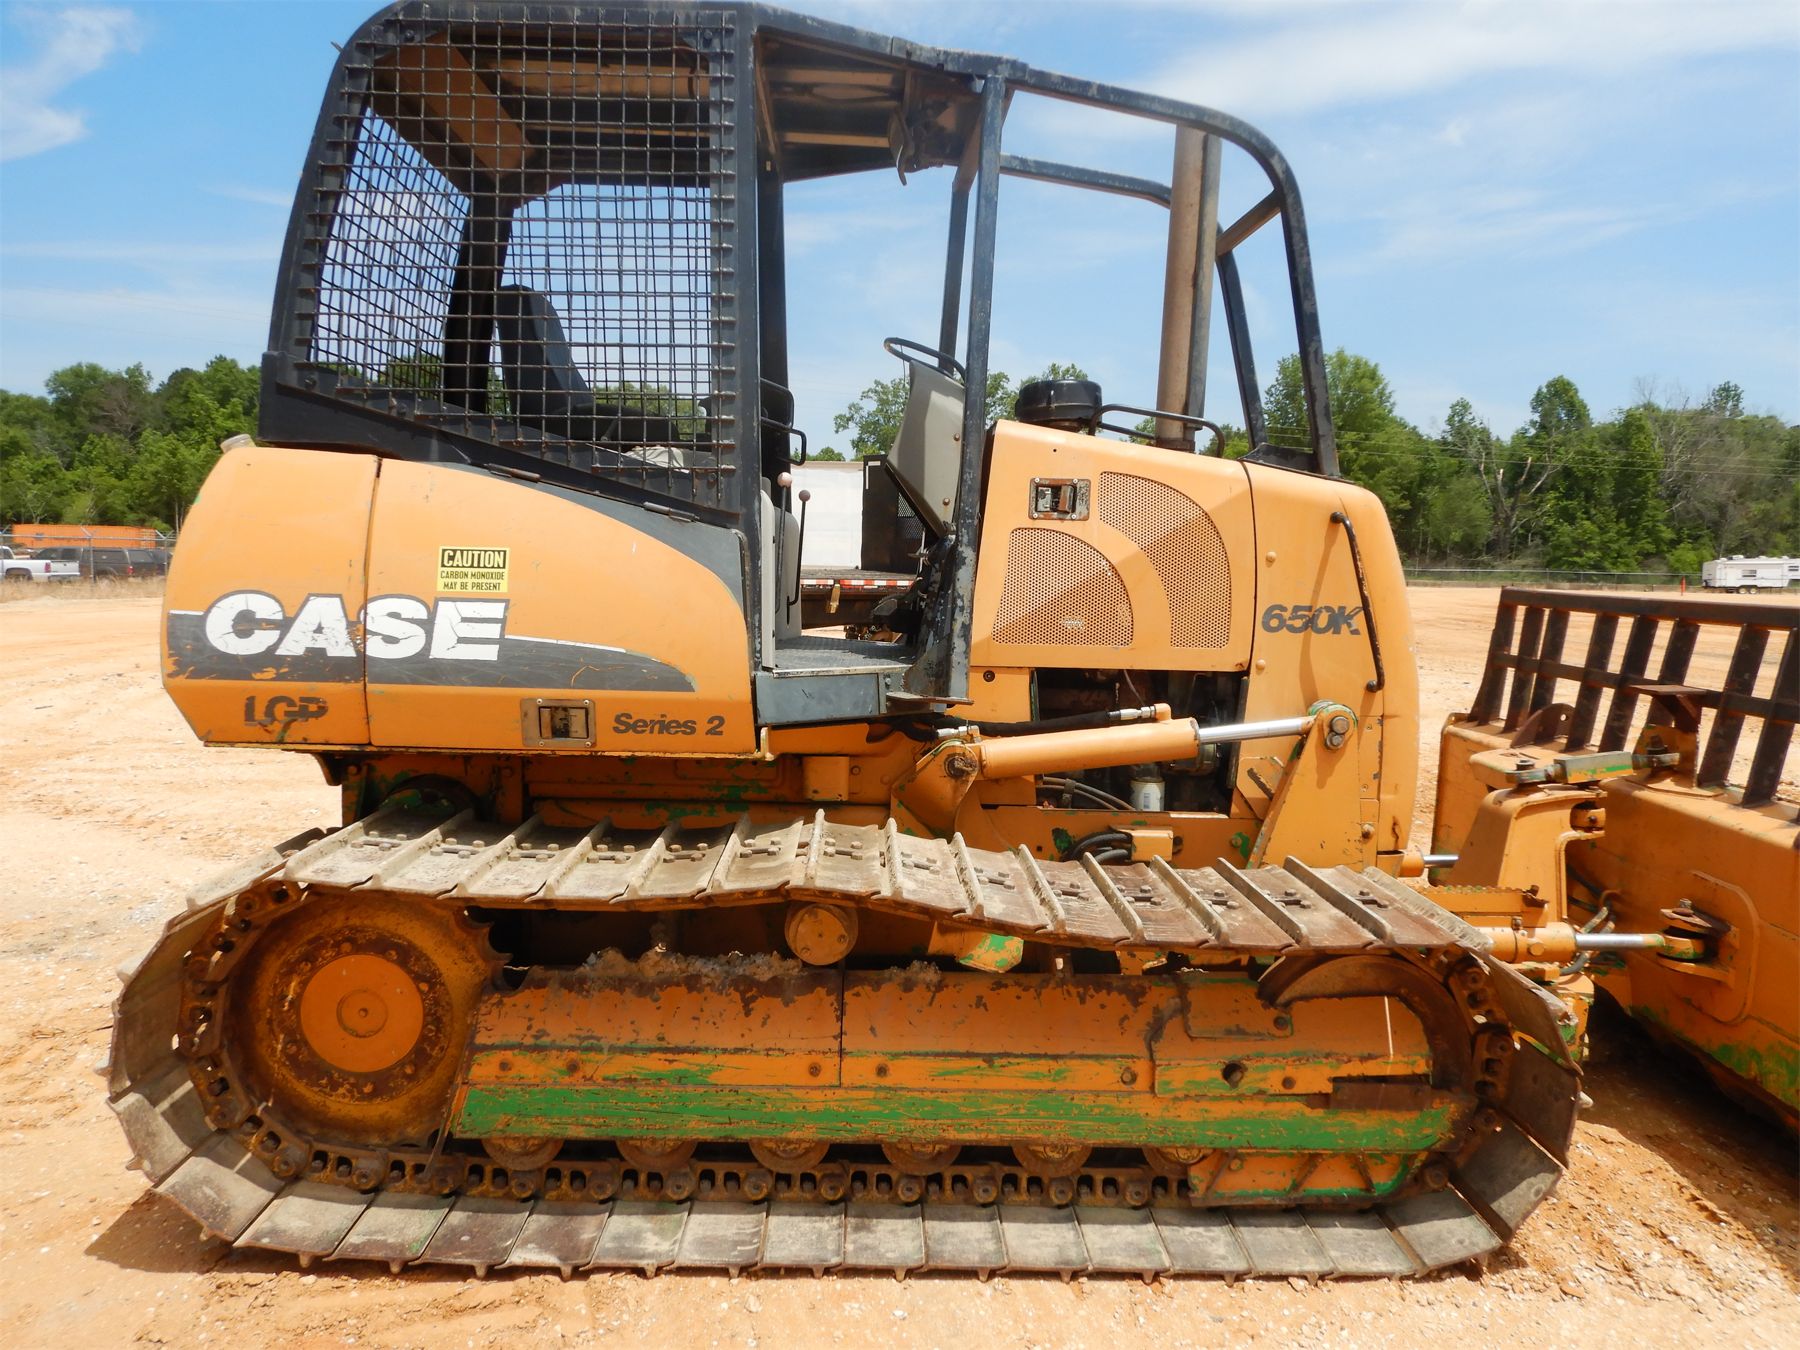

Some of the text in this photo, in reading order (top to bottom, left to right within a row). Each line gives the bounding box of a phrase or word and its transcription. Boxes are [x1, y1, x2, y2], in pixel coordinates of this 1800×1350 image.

[443, 550, 504, 567] CAUTION
[440, 570, 505, 580] CARBON MONOXIDE
[443, 581, 501, 591] MAY BE PRESENT
[205, 593, 506, 661] CASE
[1261, 604, 1363, 635] 650K
[612, 712, 726, 736] Series 2
